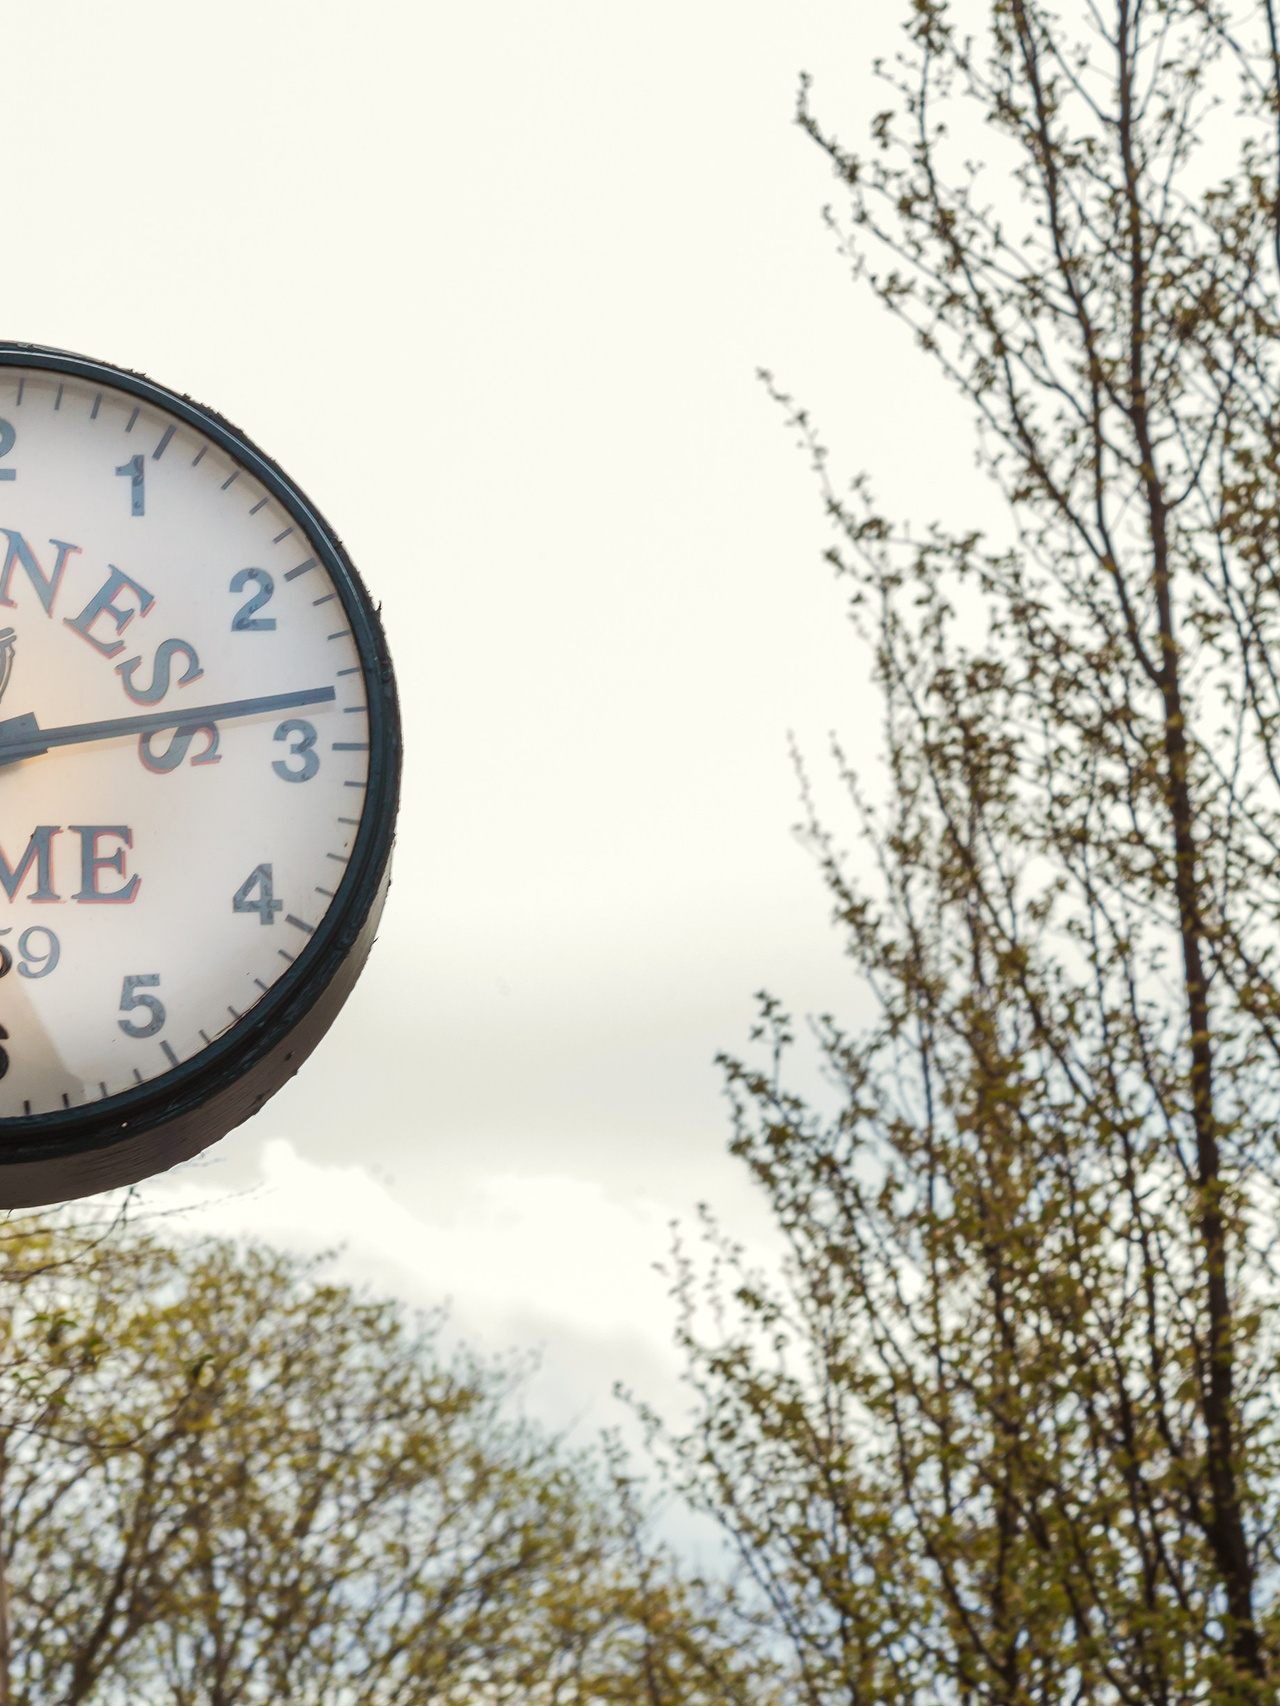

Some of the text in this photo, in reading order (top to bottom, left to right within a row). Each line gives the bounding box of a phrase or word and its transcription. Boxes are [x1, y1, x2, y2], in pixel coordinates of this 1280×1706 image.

[115, 454, 147, 516] 1
[229, 567, 278, 633] 2
[270, 719, 321, 784] 3
[231, 862, 284, 926] 4
[118, 973, 167, 1039] 5
